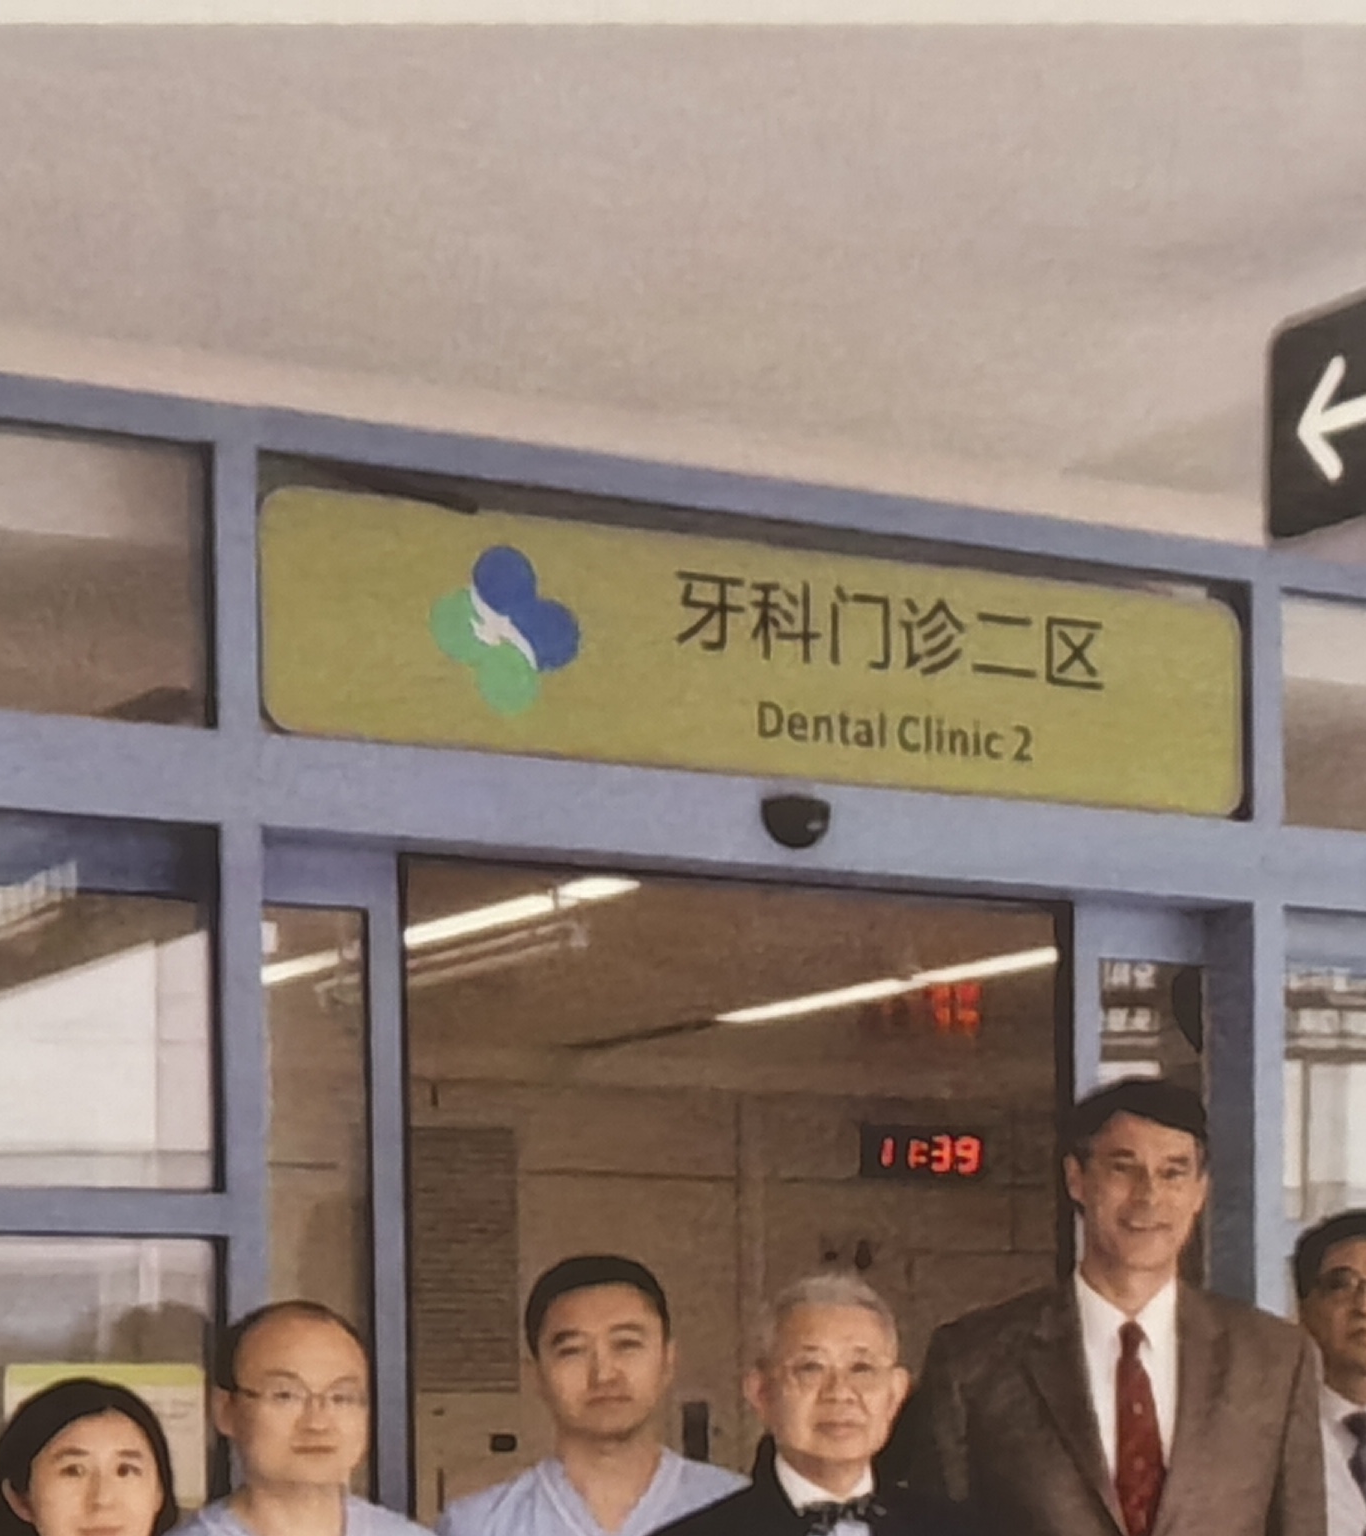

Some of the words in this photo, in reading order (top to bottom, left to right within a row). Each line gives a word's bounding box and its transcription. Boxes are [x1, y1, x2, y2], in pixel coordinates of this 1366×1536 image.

[675, 570, 1105, 691] 牙科门诊二区
[756, 700, 886, 748] Dental
[897, 714, 1005, 760] Clinic
[1011, 724, 1033, 762] 2
